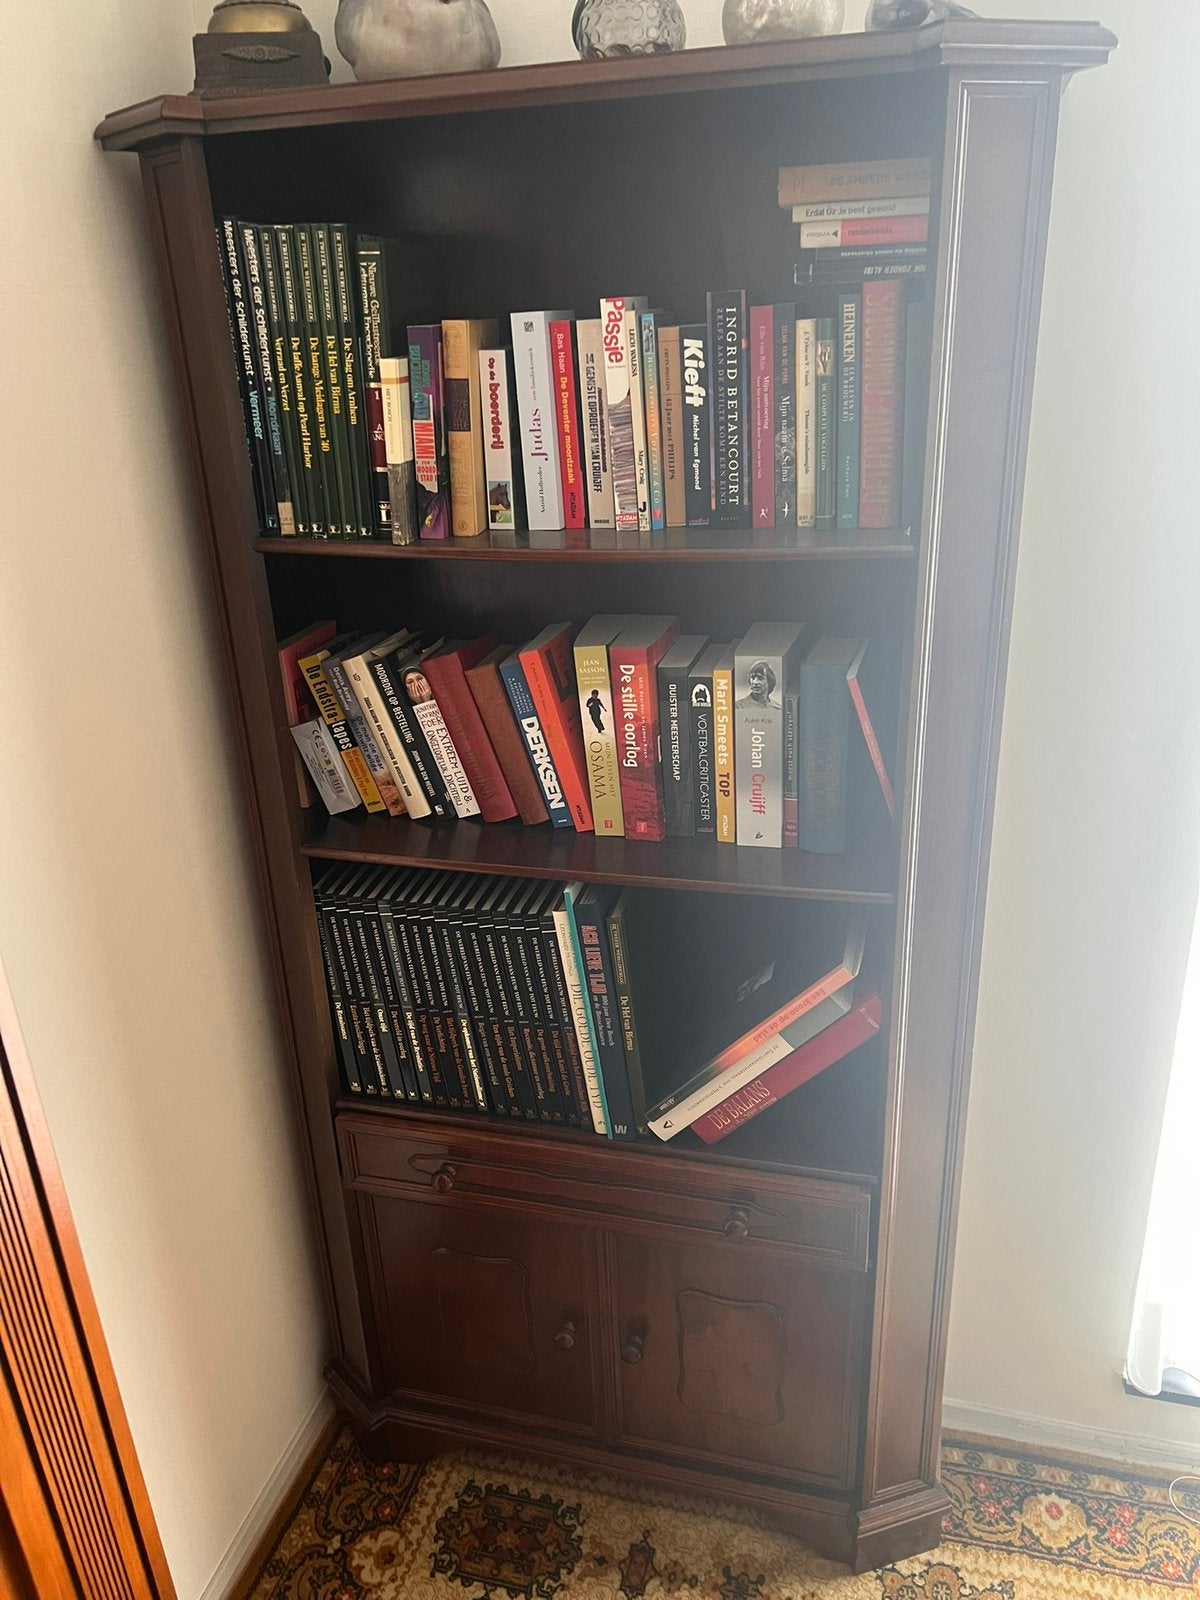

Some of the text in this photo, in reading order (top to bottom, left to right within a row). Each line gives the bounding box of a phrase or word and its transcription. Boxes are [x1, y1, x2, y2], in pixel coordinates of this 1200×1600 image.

[806, 209, 824, 217] Erdal
[848, 206, 865, 215] bent
[223, 221, 263, 440] Meesters der Schilderkunst Vermeer
[243, 230, 282, 455] Meesters der Schilderkunst Mondriaan
[326, 335, 336, 349] De
[603, 297, 625, 363] Passie
[716, 307, 724, 340] ZELFS
[843, 303, 856, 363] HEINEKEN
[309, 337, 318, 350] De
[328, 351, 338, 368] Hel
[556, 333, 566, 373] Bas Haan
[629, 328, 638, 377] LECH WALESA
[274, 337, 291, 411] Verraad en Verzet
[310, 351, 321, 379] bange
[342, 337, 359, 425] De Slag om Arnhem
[586, 366, 597, 400] GEMISTE
[683, 338, 706, 407] Kieft
[718, 370, 725, 382] DE
[291, 337, 314, 469] De laffe Aanval op Pearl Harbor
[313, 380, 326, 422] Meidagen
[330, 386, 341, 415] Birma
[489, 383, 505, 449] boerderij
[718, 387, 726, 422] STILTE
[726, 307, 739, 505] INGRID BETANCOURT
[780, 395, 790, 417] Mijn
[319, 424, 327, 438] van
[414, 422, 434, 459] MIAMI
[529, 408, 549, 461] Judas
[560, 376, 575, 484] De Deventer moordzaak
[588, 402, 600, 443] OPROEPEN
[692, 414, 701, 440] Michel
[591, 444, 601, 460] VAN
[637, 450, 645, 467] Mary
[782, 455, 790, 482] Selma
[592, 461, 603, 493] CRUIJFF
[692, 459, 702, 490] Egmond
[305, 665, 320, 679] De
[332, 666, 346, 686] Denis
[341, 687, 353, 702] Avey
[374, 663, 415, 743] MOORDEN OP BESTELLING
[619, 664, 641, 768] De stille oorlog
[357, 716, 384, 770] De man die naar
[669, 684, 680, 781] DUISTER MEESTERSCHAP
[716, 679, 730, 798] Mart Smeets TOP
[365, 754, 378, 772] wilde
[437, 727, 473, 804] EXTREEM LUID &
[520, 716, 566, 810] DERKSEN
[590, 741, 607, 799] OSAMA
[697, 714, 710, 821] VOETBALCRITICASTER
[749, 727, 766, 815] Johan Cruijff
[581, 925, 599, 944] ACH
[584, 947, 603, 970] LIEVE
[571, 983, 584, 1004] DIE
[589, 973, 607, 994] TIJD
[575, 1008, 590, 1047] GOEDE
[620, 996, 634, 1051] De Hel van Birma
[583, 1051, 598, 1082] OUDE
[590, 1086, 603, 1109] TYD
[709, 1109, 730, 1130] DE
[729, 1079, 771, 1121] BALANS
